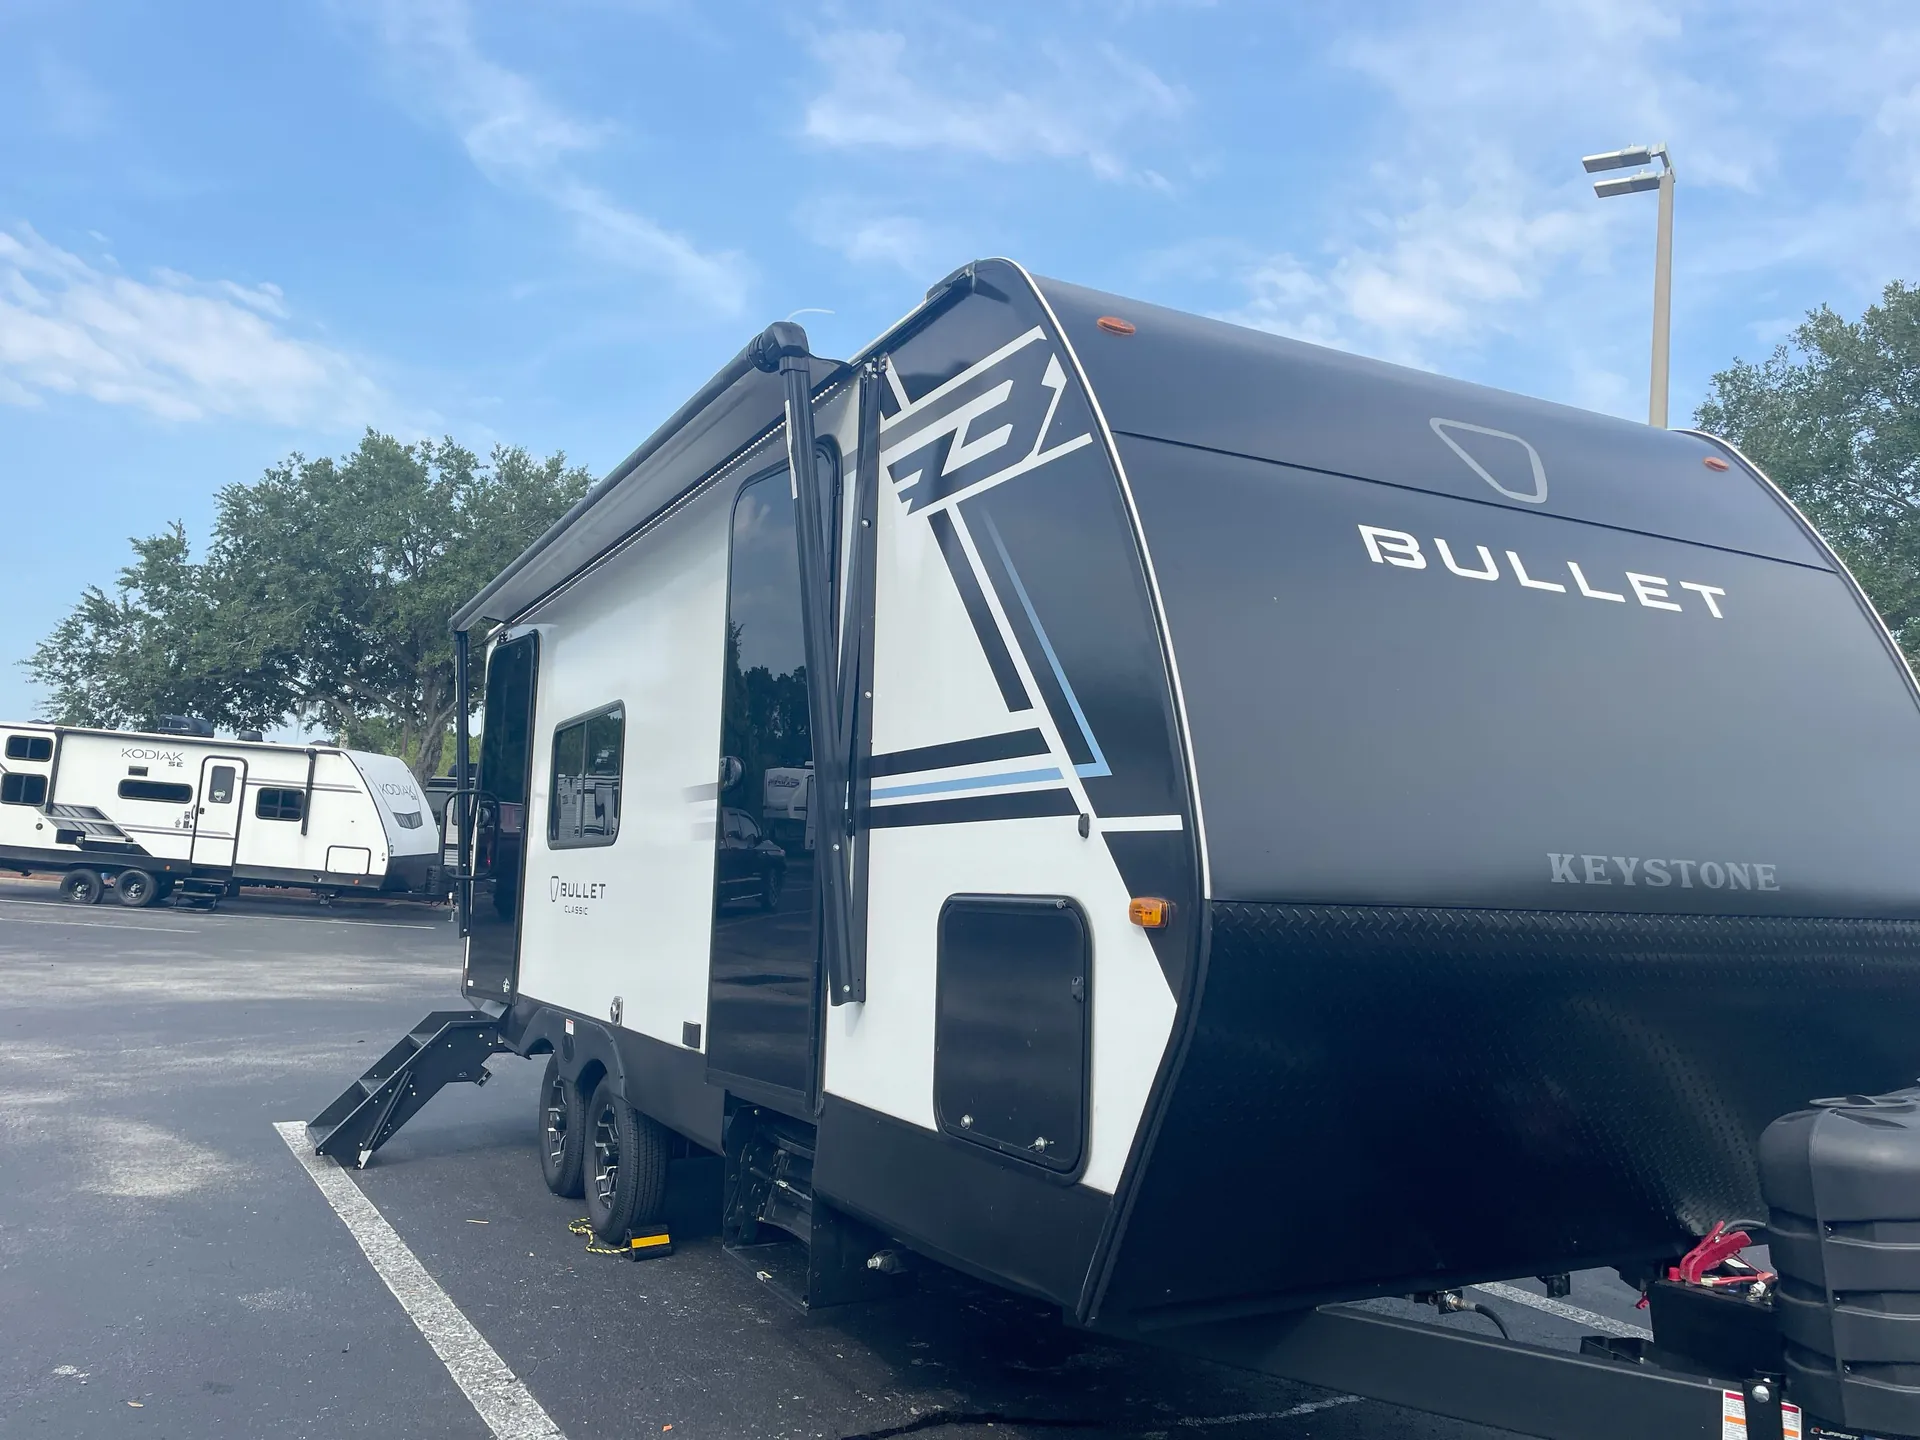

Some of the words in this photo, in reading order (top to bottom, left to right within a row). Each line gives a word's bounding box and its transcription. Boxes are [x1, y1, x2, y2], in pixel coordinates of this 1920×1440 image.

[1357, 524, 1726, 619] BULLET
[121, 748, 184, 762] KODIAK
[1546, 853, 1780, 892] KEYSTONE
[561, 882, 606, 899] BULLET
[564, 905, 588, 915] CLASSIC
